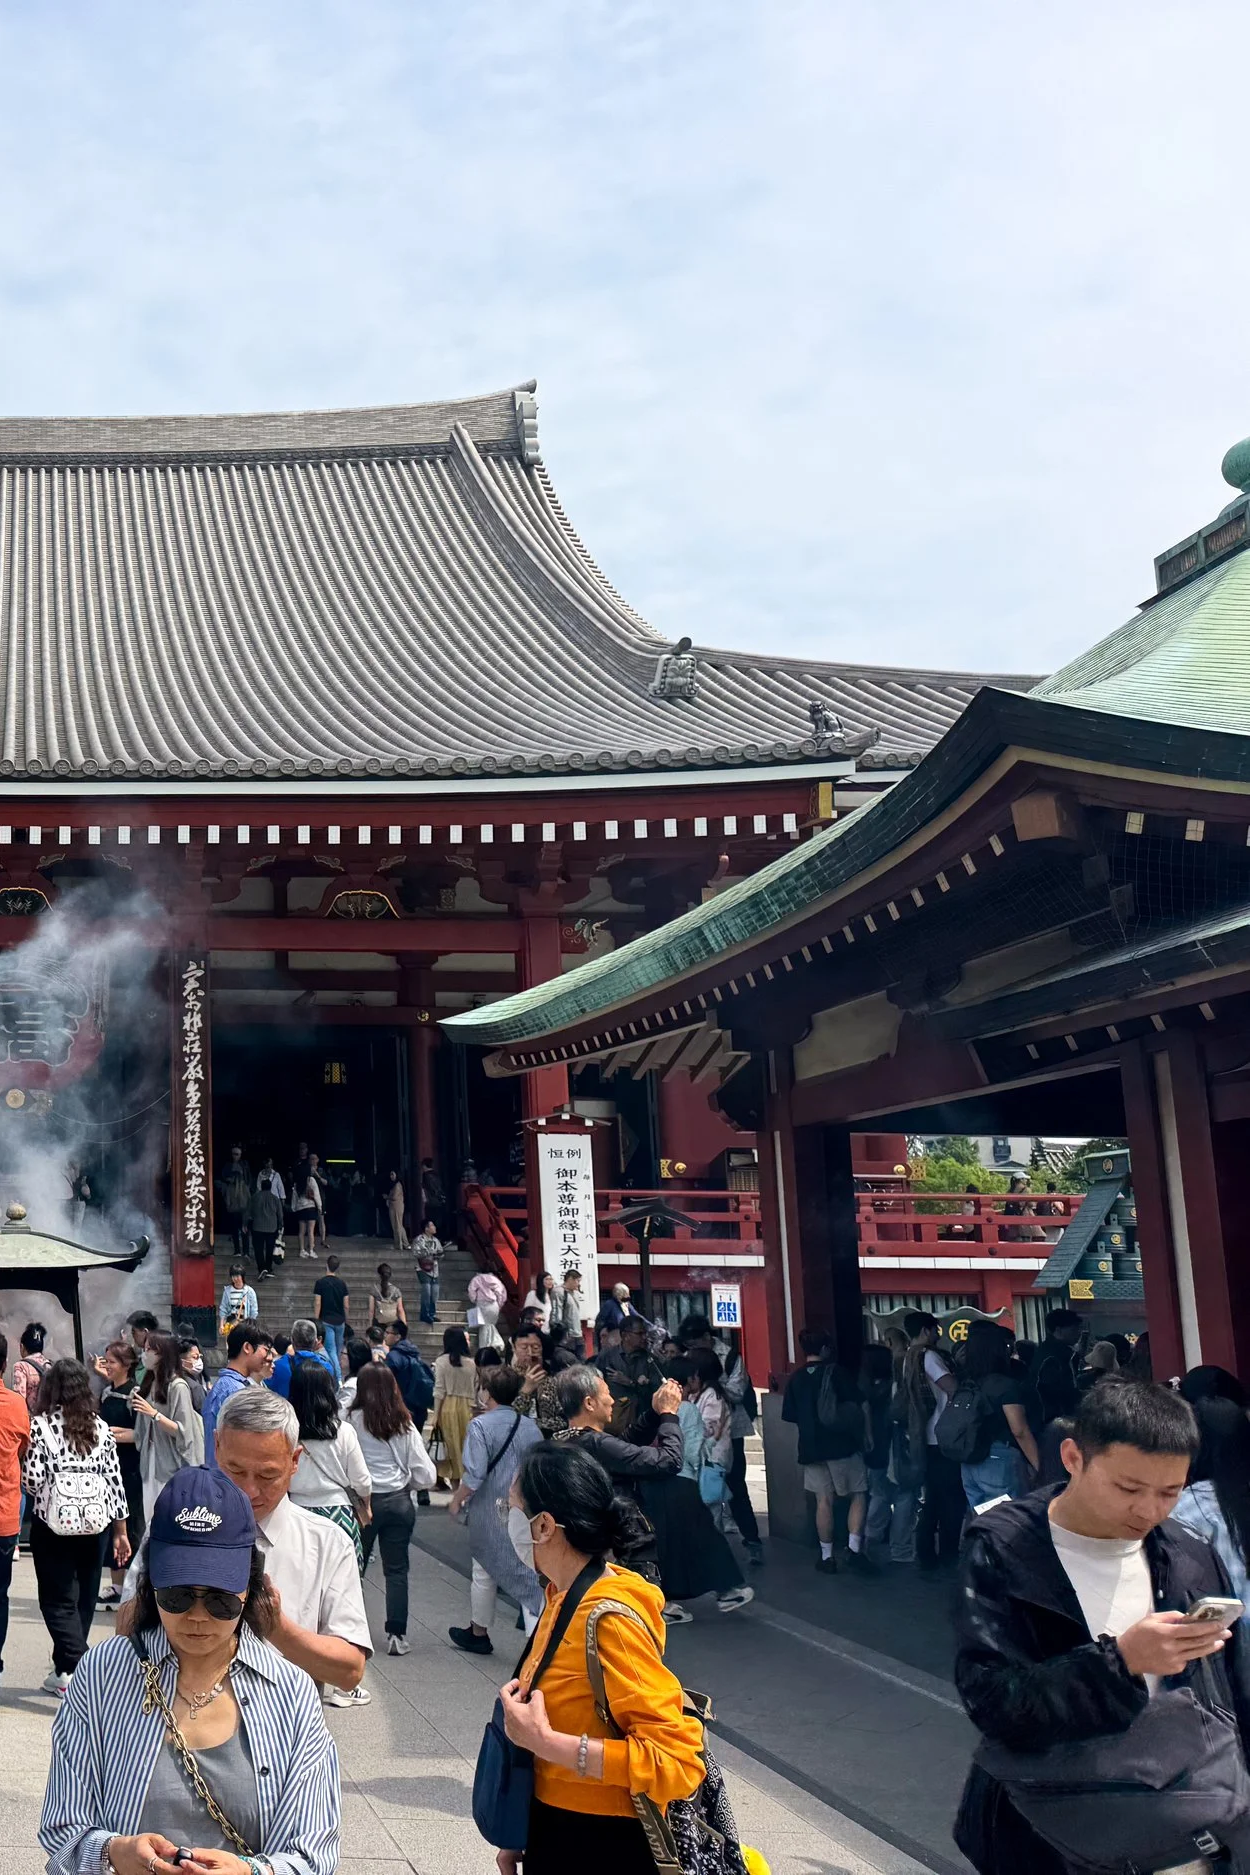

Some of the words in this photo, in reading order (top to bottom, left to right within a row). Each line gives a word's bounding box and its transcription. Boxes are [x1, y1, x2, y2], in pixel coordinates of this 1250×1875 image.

[547, 1148, 581, 1159] 恒例
[554, 1167, 585, 1301] 御本尊御縁日大祈
[175, 1505, 223, 1527] Sublime
